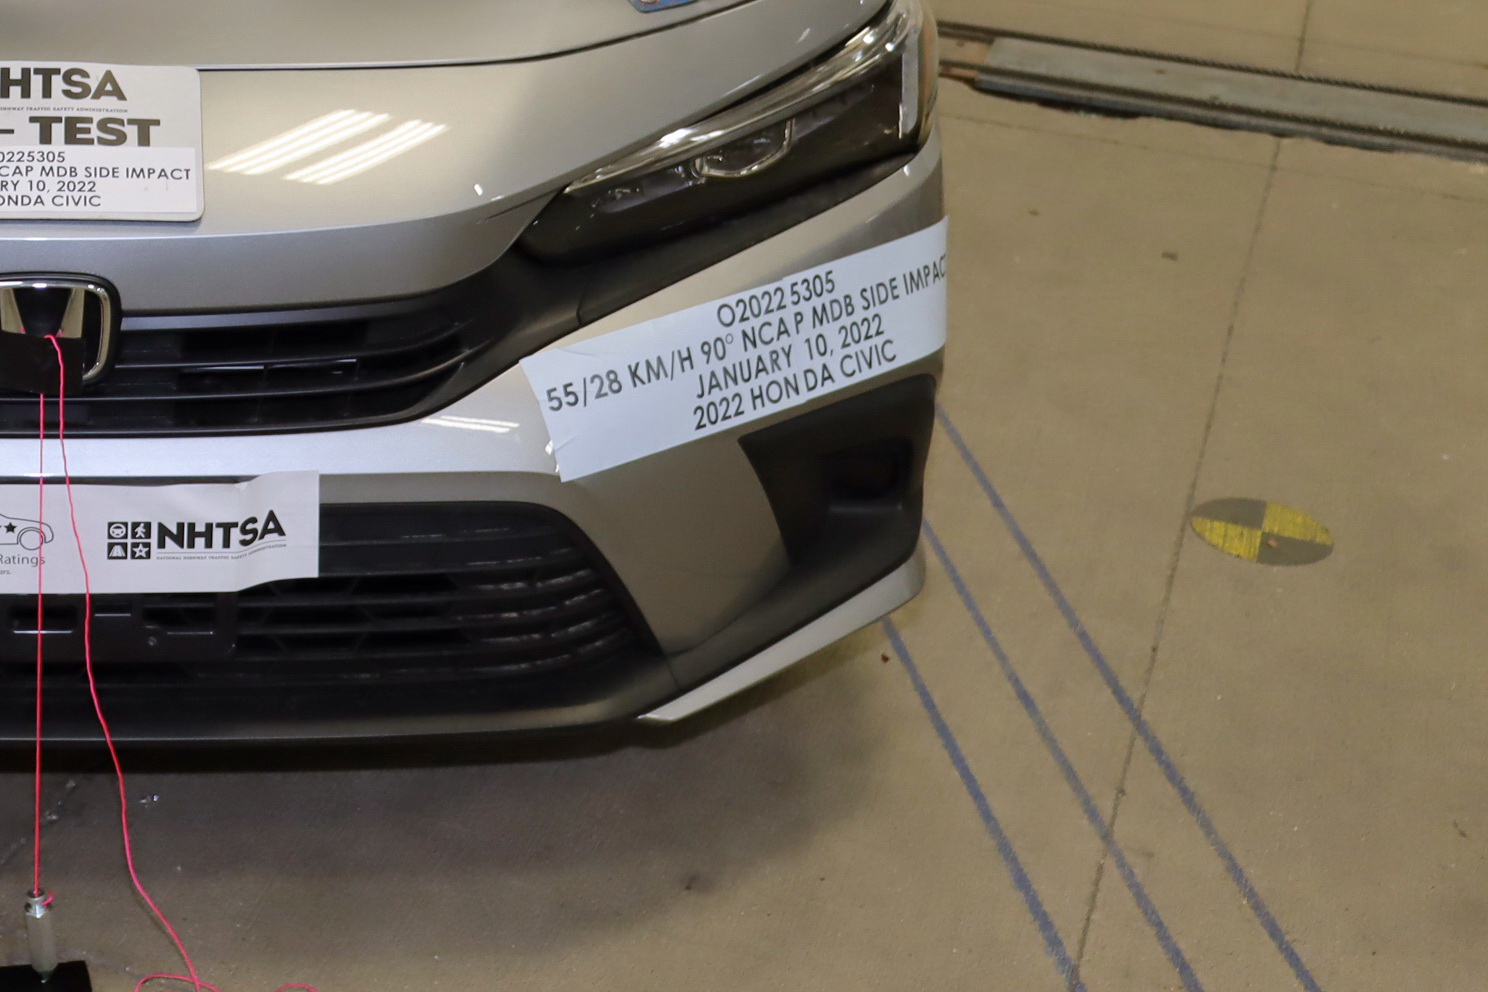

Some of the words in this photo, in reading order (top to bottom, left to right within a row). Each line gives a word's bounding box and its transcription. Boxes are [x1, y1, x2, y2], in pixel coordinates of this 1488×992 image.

[29, 116, 160, 147] TEST
[27, 180, 51, 194] 10,
[56, 180, 96, 192] 2022
[40, 165, 78, 178] MDB
[84, 166, 119, 179] SIDE
[125, 167, 191, 181] IMPACT
[51, 195, 101, 207] CIVIC
[545, 369, 622, 412] 55/28
[628, 346, 694, 386] KM/H
[701, 332, 734, 365] 90°
[741, 310, 804, 352] NCAP
[813, 297, 855, 329] MDB
[860, 277, 899, 311] SIDE
[695, 344, 793, 399] JANUARY
[805, 332, 834, 362] 10,
[839, 313, 885, 349] 2022
[694, 393, 745, 432] 2022
[752, 369, 835, 411] HONDA
[840, 339, 897, 378] CIVIC
[157, 509, 286, 549] NHTSA
